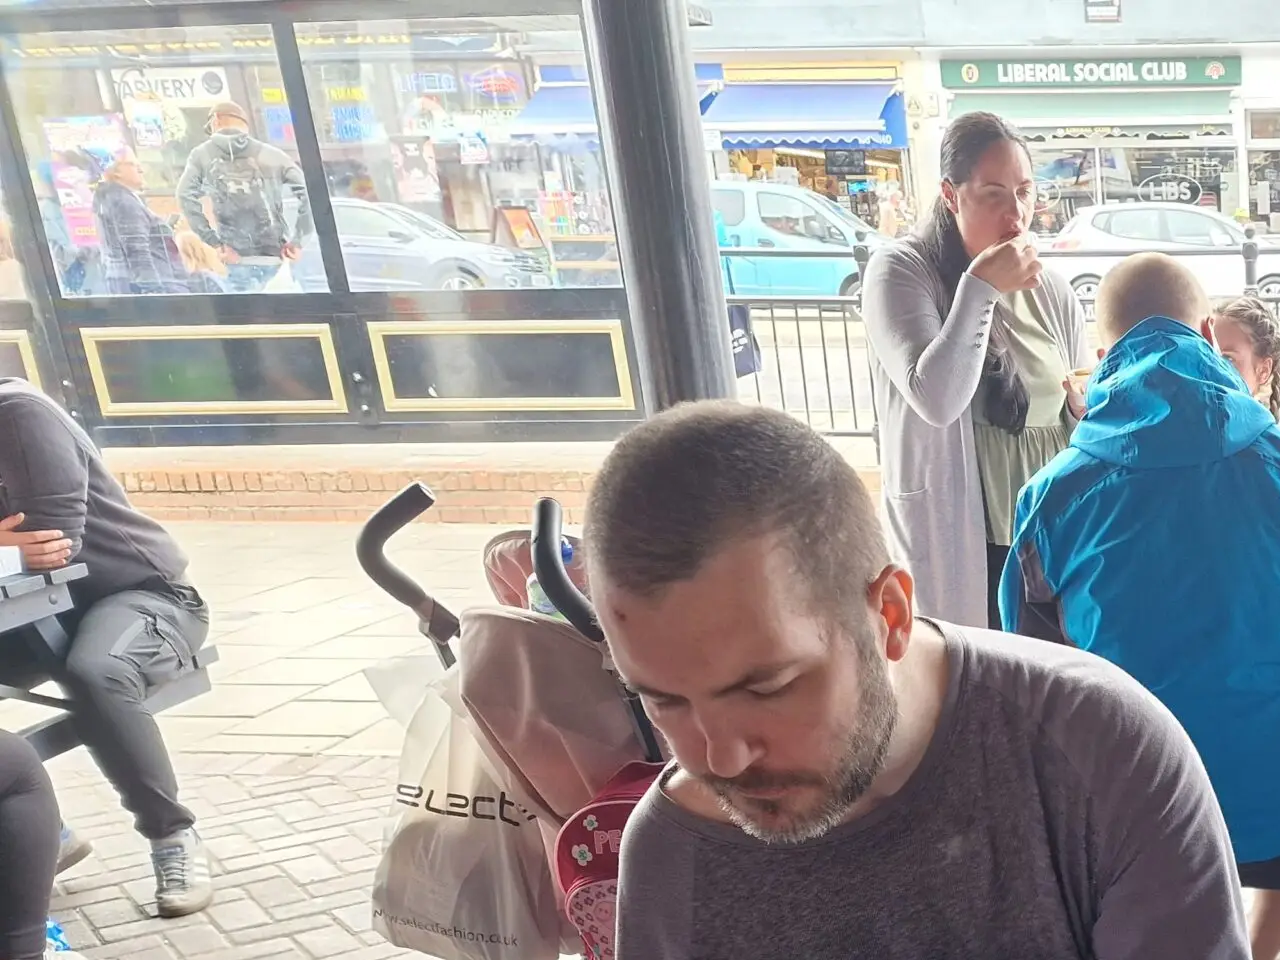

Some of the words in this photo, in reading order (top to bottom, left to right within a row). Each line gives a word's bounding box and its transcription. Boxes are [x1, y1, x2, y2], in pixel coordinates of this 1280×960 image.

[997, 62, 1071, 83] LIBERAL
[1073, 62, 1137, 82] SOCIAL
[1140, 61, 1188, 81] CLUB
[1149, 181, 1192, 201] LIBS
